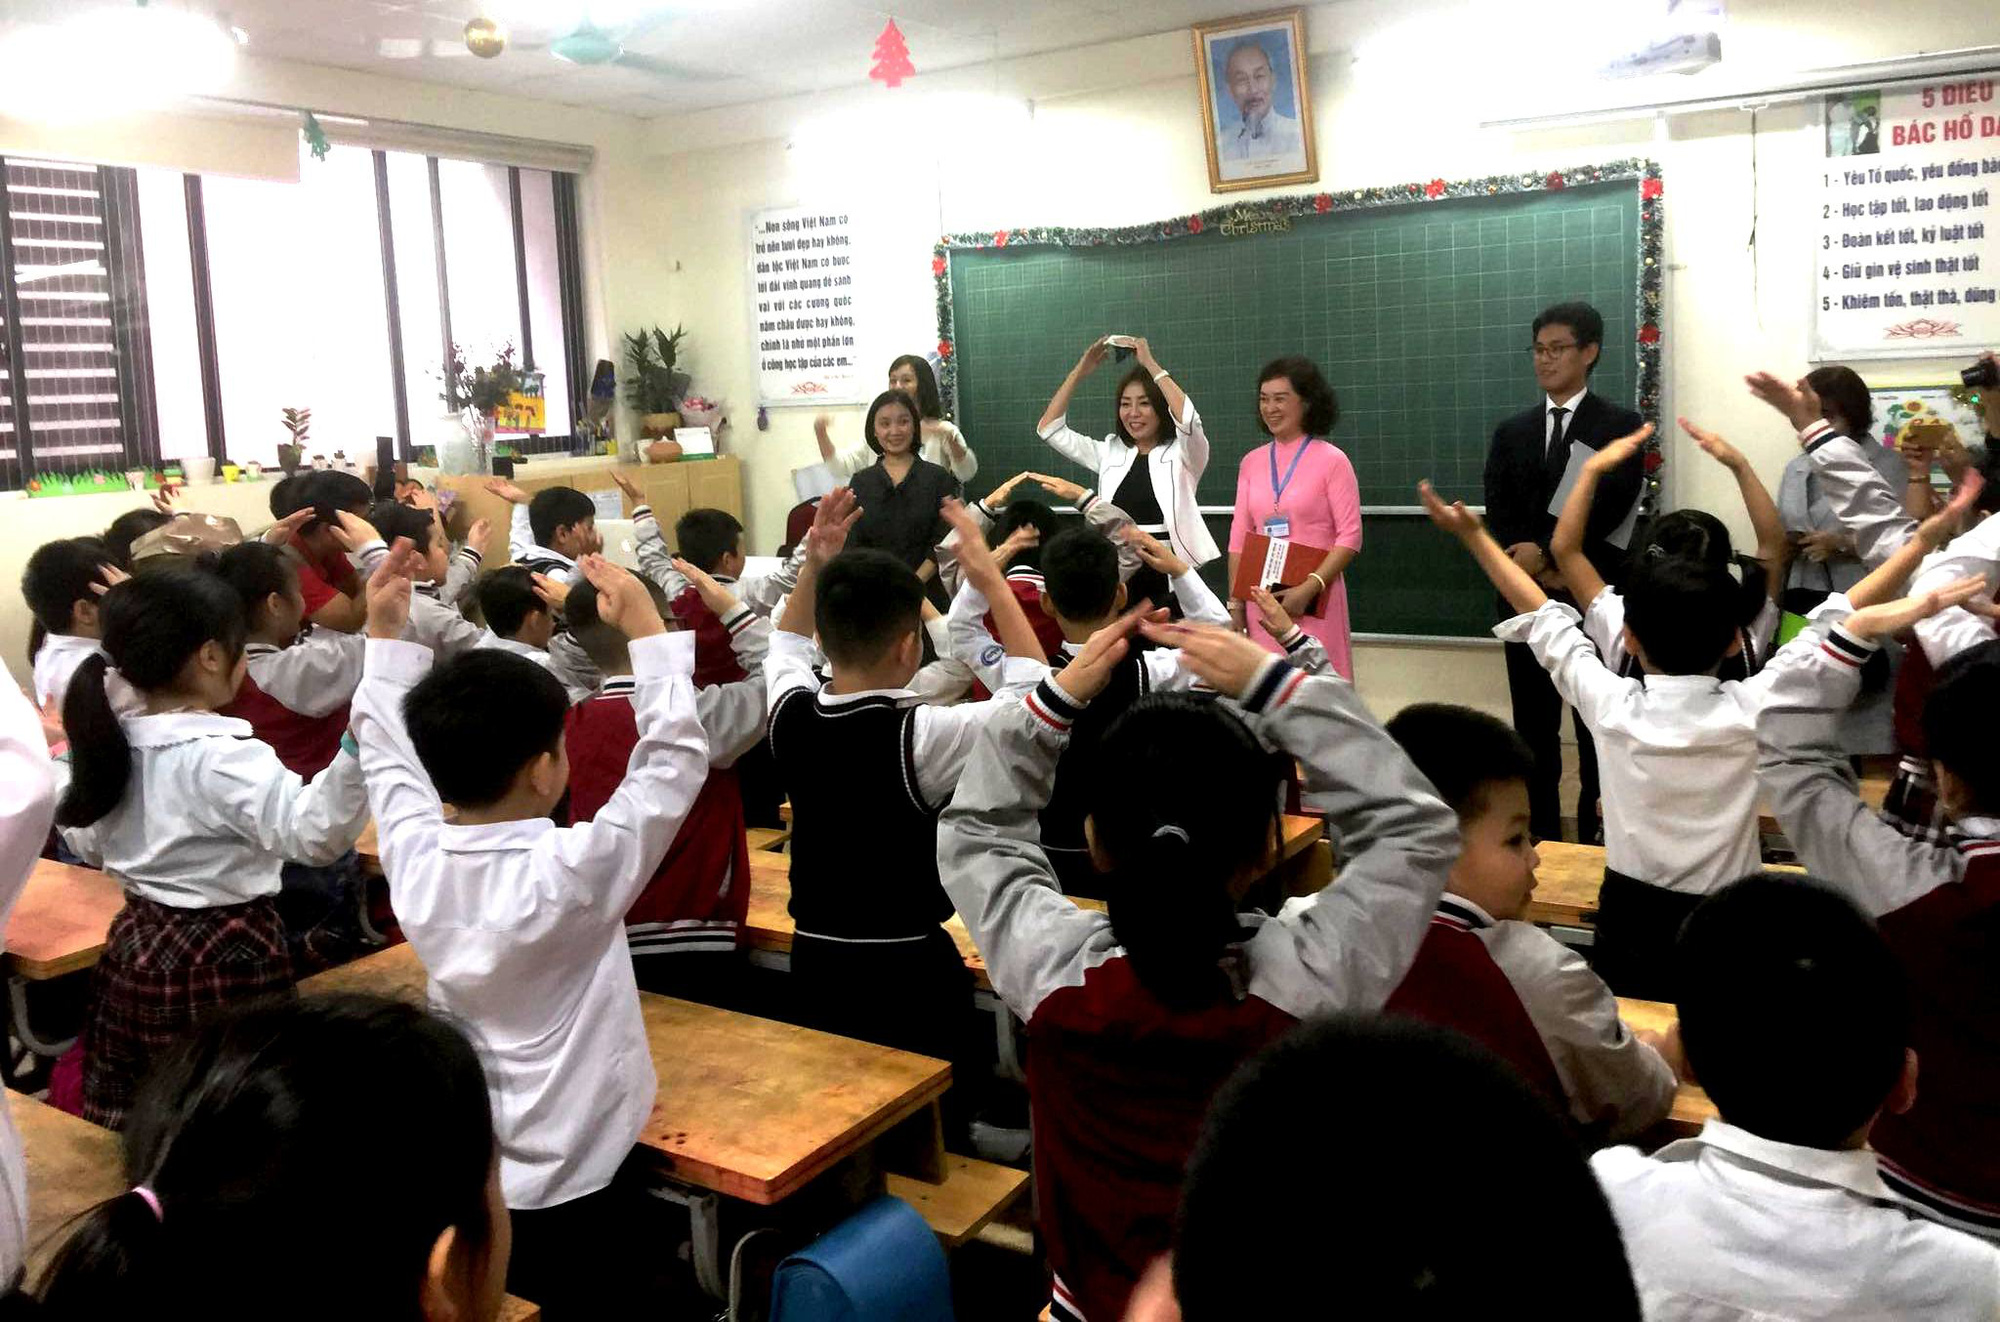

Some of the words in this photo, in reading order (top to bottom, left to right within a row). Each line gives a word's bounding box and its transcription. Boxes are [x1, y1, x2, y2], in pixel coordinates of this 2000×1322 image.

[1922, 87, 1935, 108] 5
[1892, 119, 1936, 146] BÁC
[1943, 111, 1973, 140] HỒ
[1824, 174, 1829, 187] 1
[1844, 169, 1865, 186] Yêu
[1921, 162, 1943, 180] yêu
[1823, 204, 1830, 219] 2
[1842, 202, 1865, 219] Học
[1868, 199, 1887, 218] tập
[1915, 197, 1934, 211] lao
[1937, 193, 1968, 212] động
[819, 215, 836, 227] Nam
[812, 237, 824, 249] hay
[1823, 234, 1830, 250] 3
[1842, 232, 1872, 248] Đoàn
[1876, 228, 1895, 245] kết
[801, 257, 818, 270] Nam
[1823, 266, 1830, 280] 4
[1888, 260, 1902, 279] vệ
[1905, 259, 1931, 275] sinh
[799, 278, 821, 291] quang
[758, 300, 770, 313] vai
[1823, 296, 1830, 311] 5
[1842, 293, 1880, 309] Khiêm
[815, 316, 828, 328] hay
